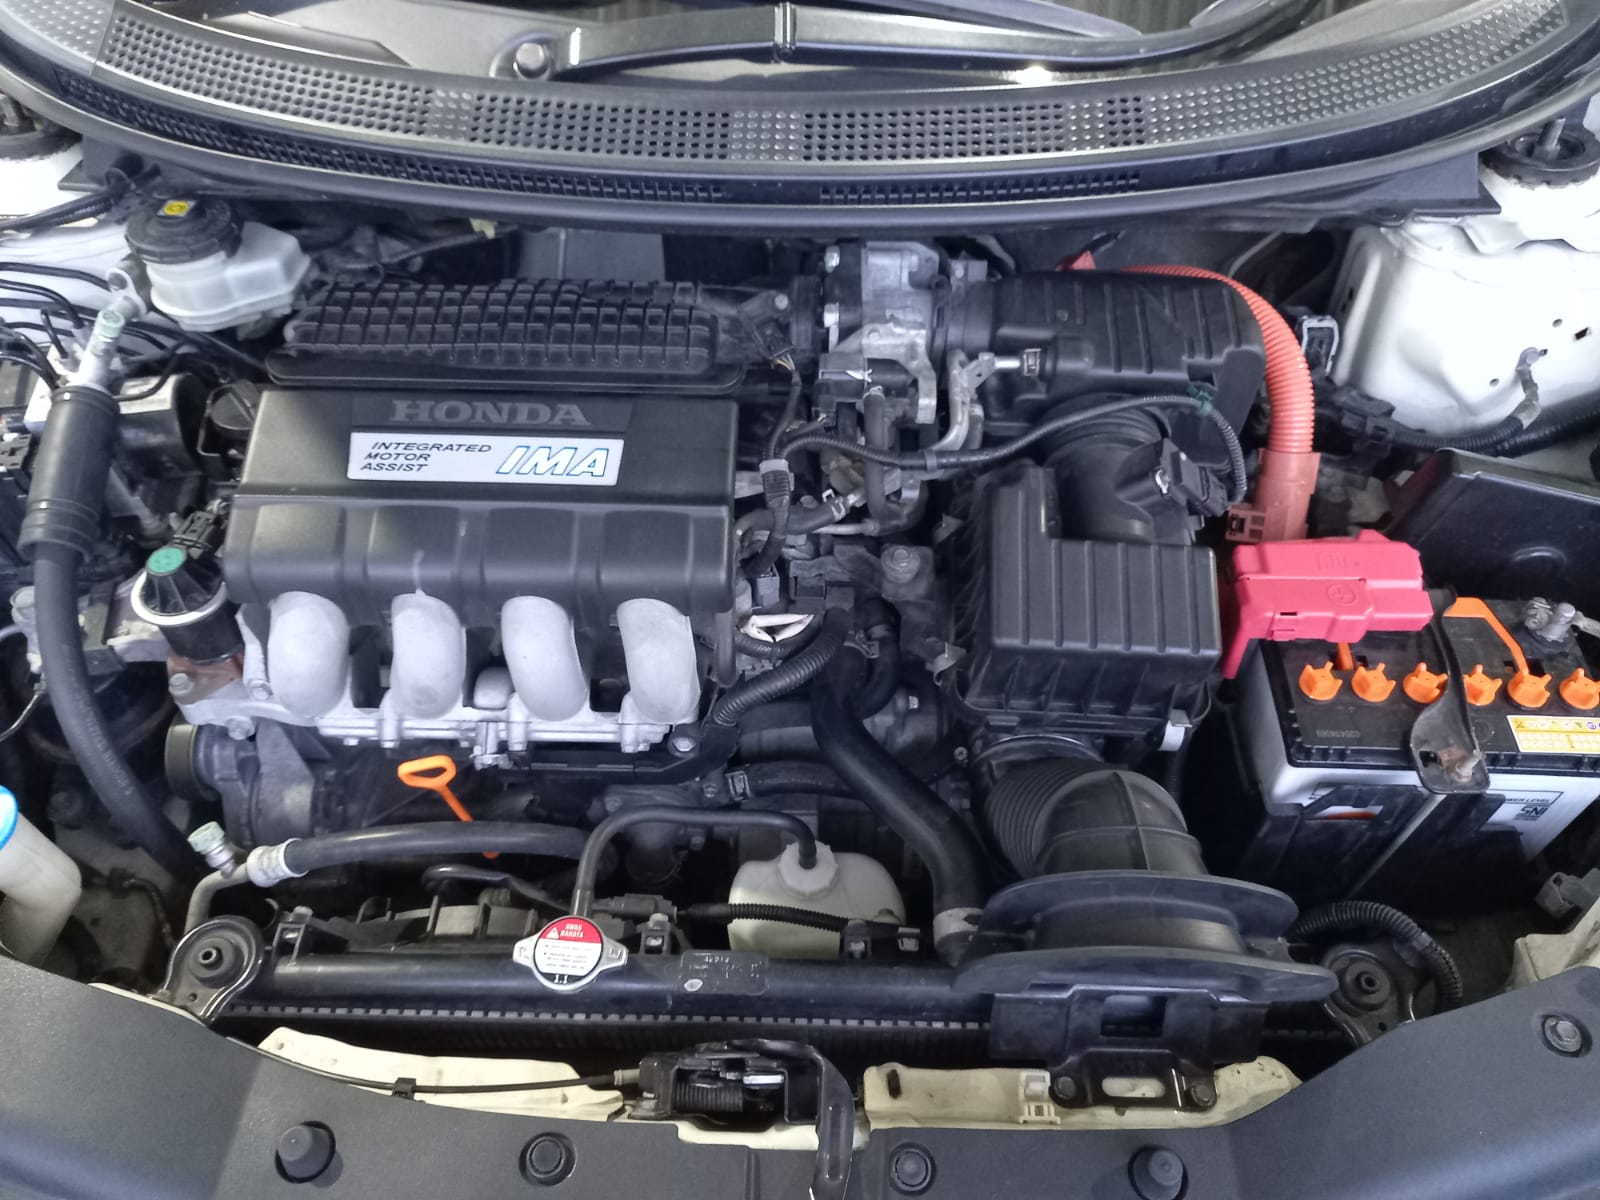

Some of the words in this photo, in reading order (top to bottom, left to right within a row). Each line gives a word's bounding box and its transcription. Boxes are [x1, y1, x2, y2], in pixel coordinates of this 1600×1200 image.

[389, 400, 591, 426] HONDA
[371, 441, 493, 454] INTEGRATED
[364, 452, 431, 463] MOTOR
[495, 444, 610, 478] IMA
[360, 461, 428, 473] ASSIST
[1521, 806, 1548, 815] SNI
[564, 923, 583, 931] AWAS
[559, 930, 584, 938] BAHAYA
[554, 974, 569, 984] 1.1
